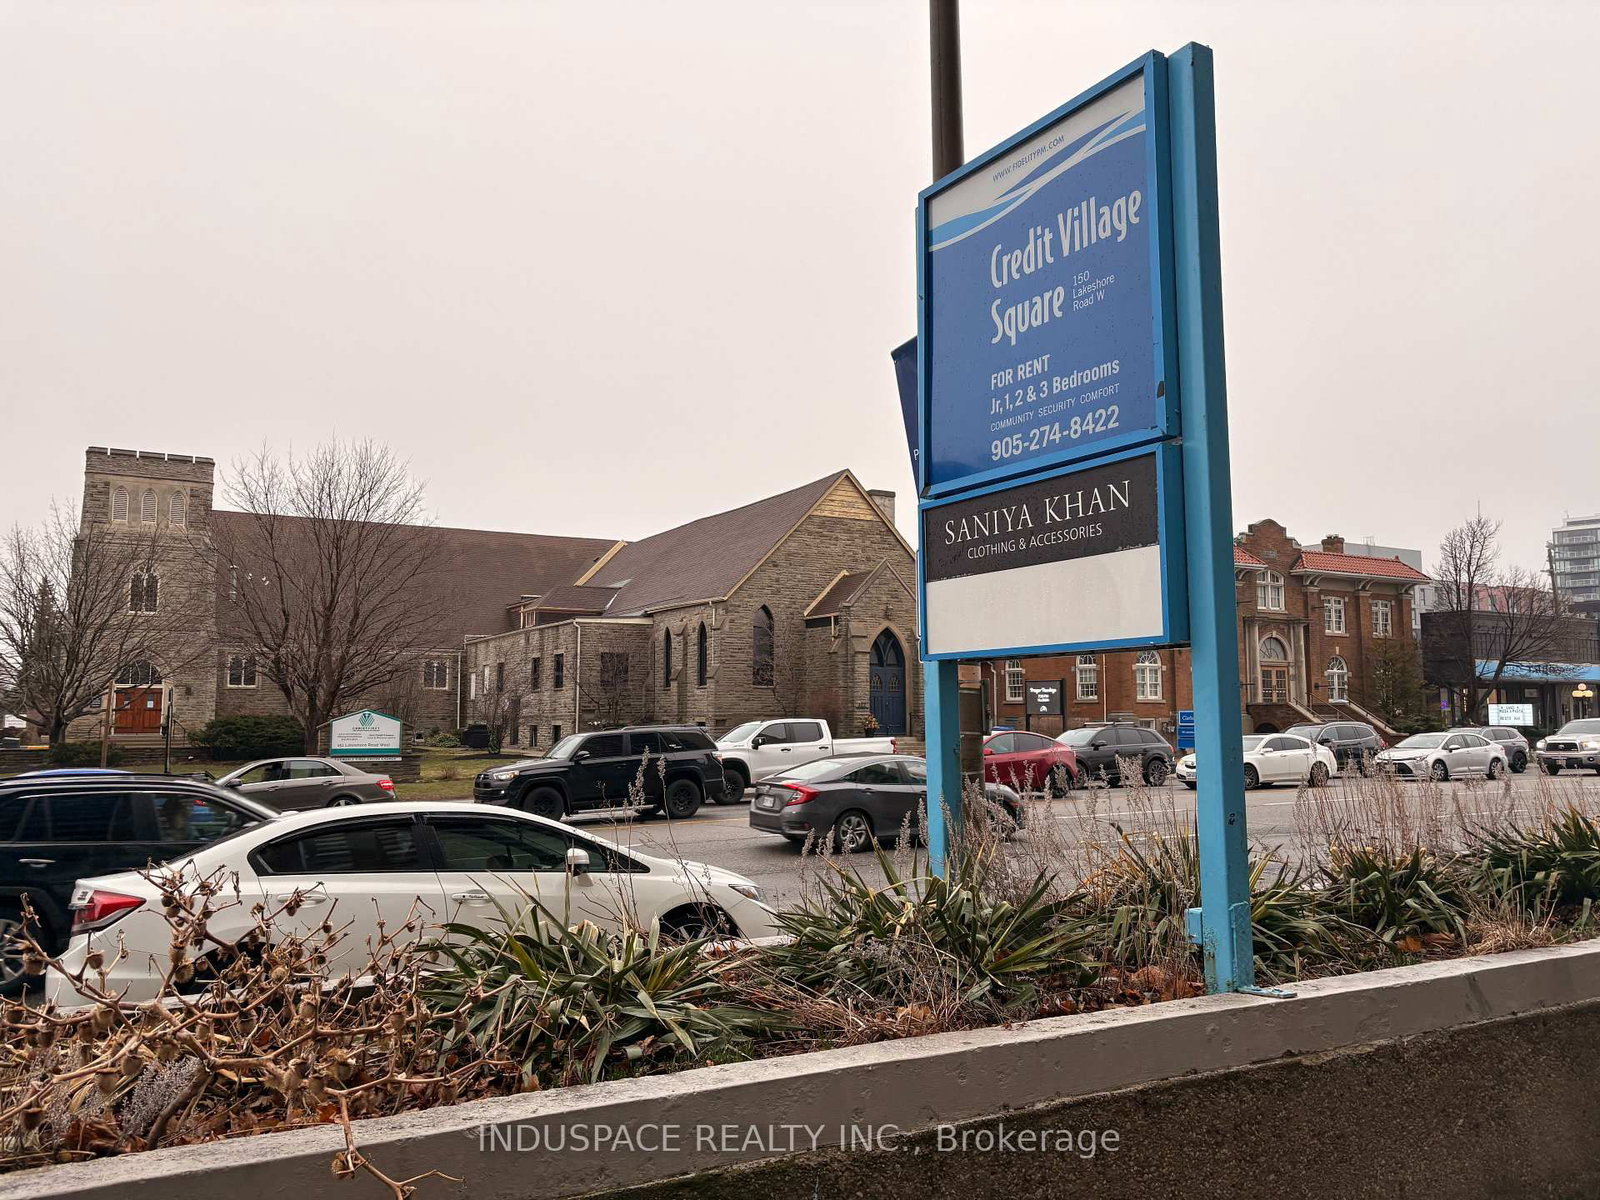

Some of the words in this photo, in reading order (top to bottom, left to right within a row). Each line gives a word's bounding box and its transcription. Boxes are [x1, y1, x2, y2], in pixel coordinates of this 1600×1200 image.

[990, 225, 1054, 288] Credit
[1057, 190, 1142, 257] Village
[1072, 270, 1090, 287] 150
[1072, 274, 1115, 299] Lakeshore
[1072, 294, 1094, 311] Road
[1096, 289, 1105, 301] W
[991, 286, 1065, 346] Square
[991, 368, 1014, 391] FOR
[1017, 354, 1051, 382] RENT
[1026, 385, 1037, 402] &
[1039, 380, 1049, 399] 3
[1052, 359, 1120, 394] Bedrooms
[990, 409, 1035, 432] COMMUNITY
[1038, 396, 1076, 417] SECURITY
[1080, 382, 1120, 404] COMFORT
[991, 404, 1120, 461] 905-274-8422
[945, 503, 1035, 545] SANIYA
[1044, 479, 1131, 525] KHAN
[967, 539, 1016, 560] CLOTHING
[1018, 537, 1027, 550] &
[1029, 522, 1103, 548] ACCESSORIES
